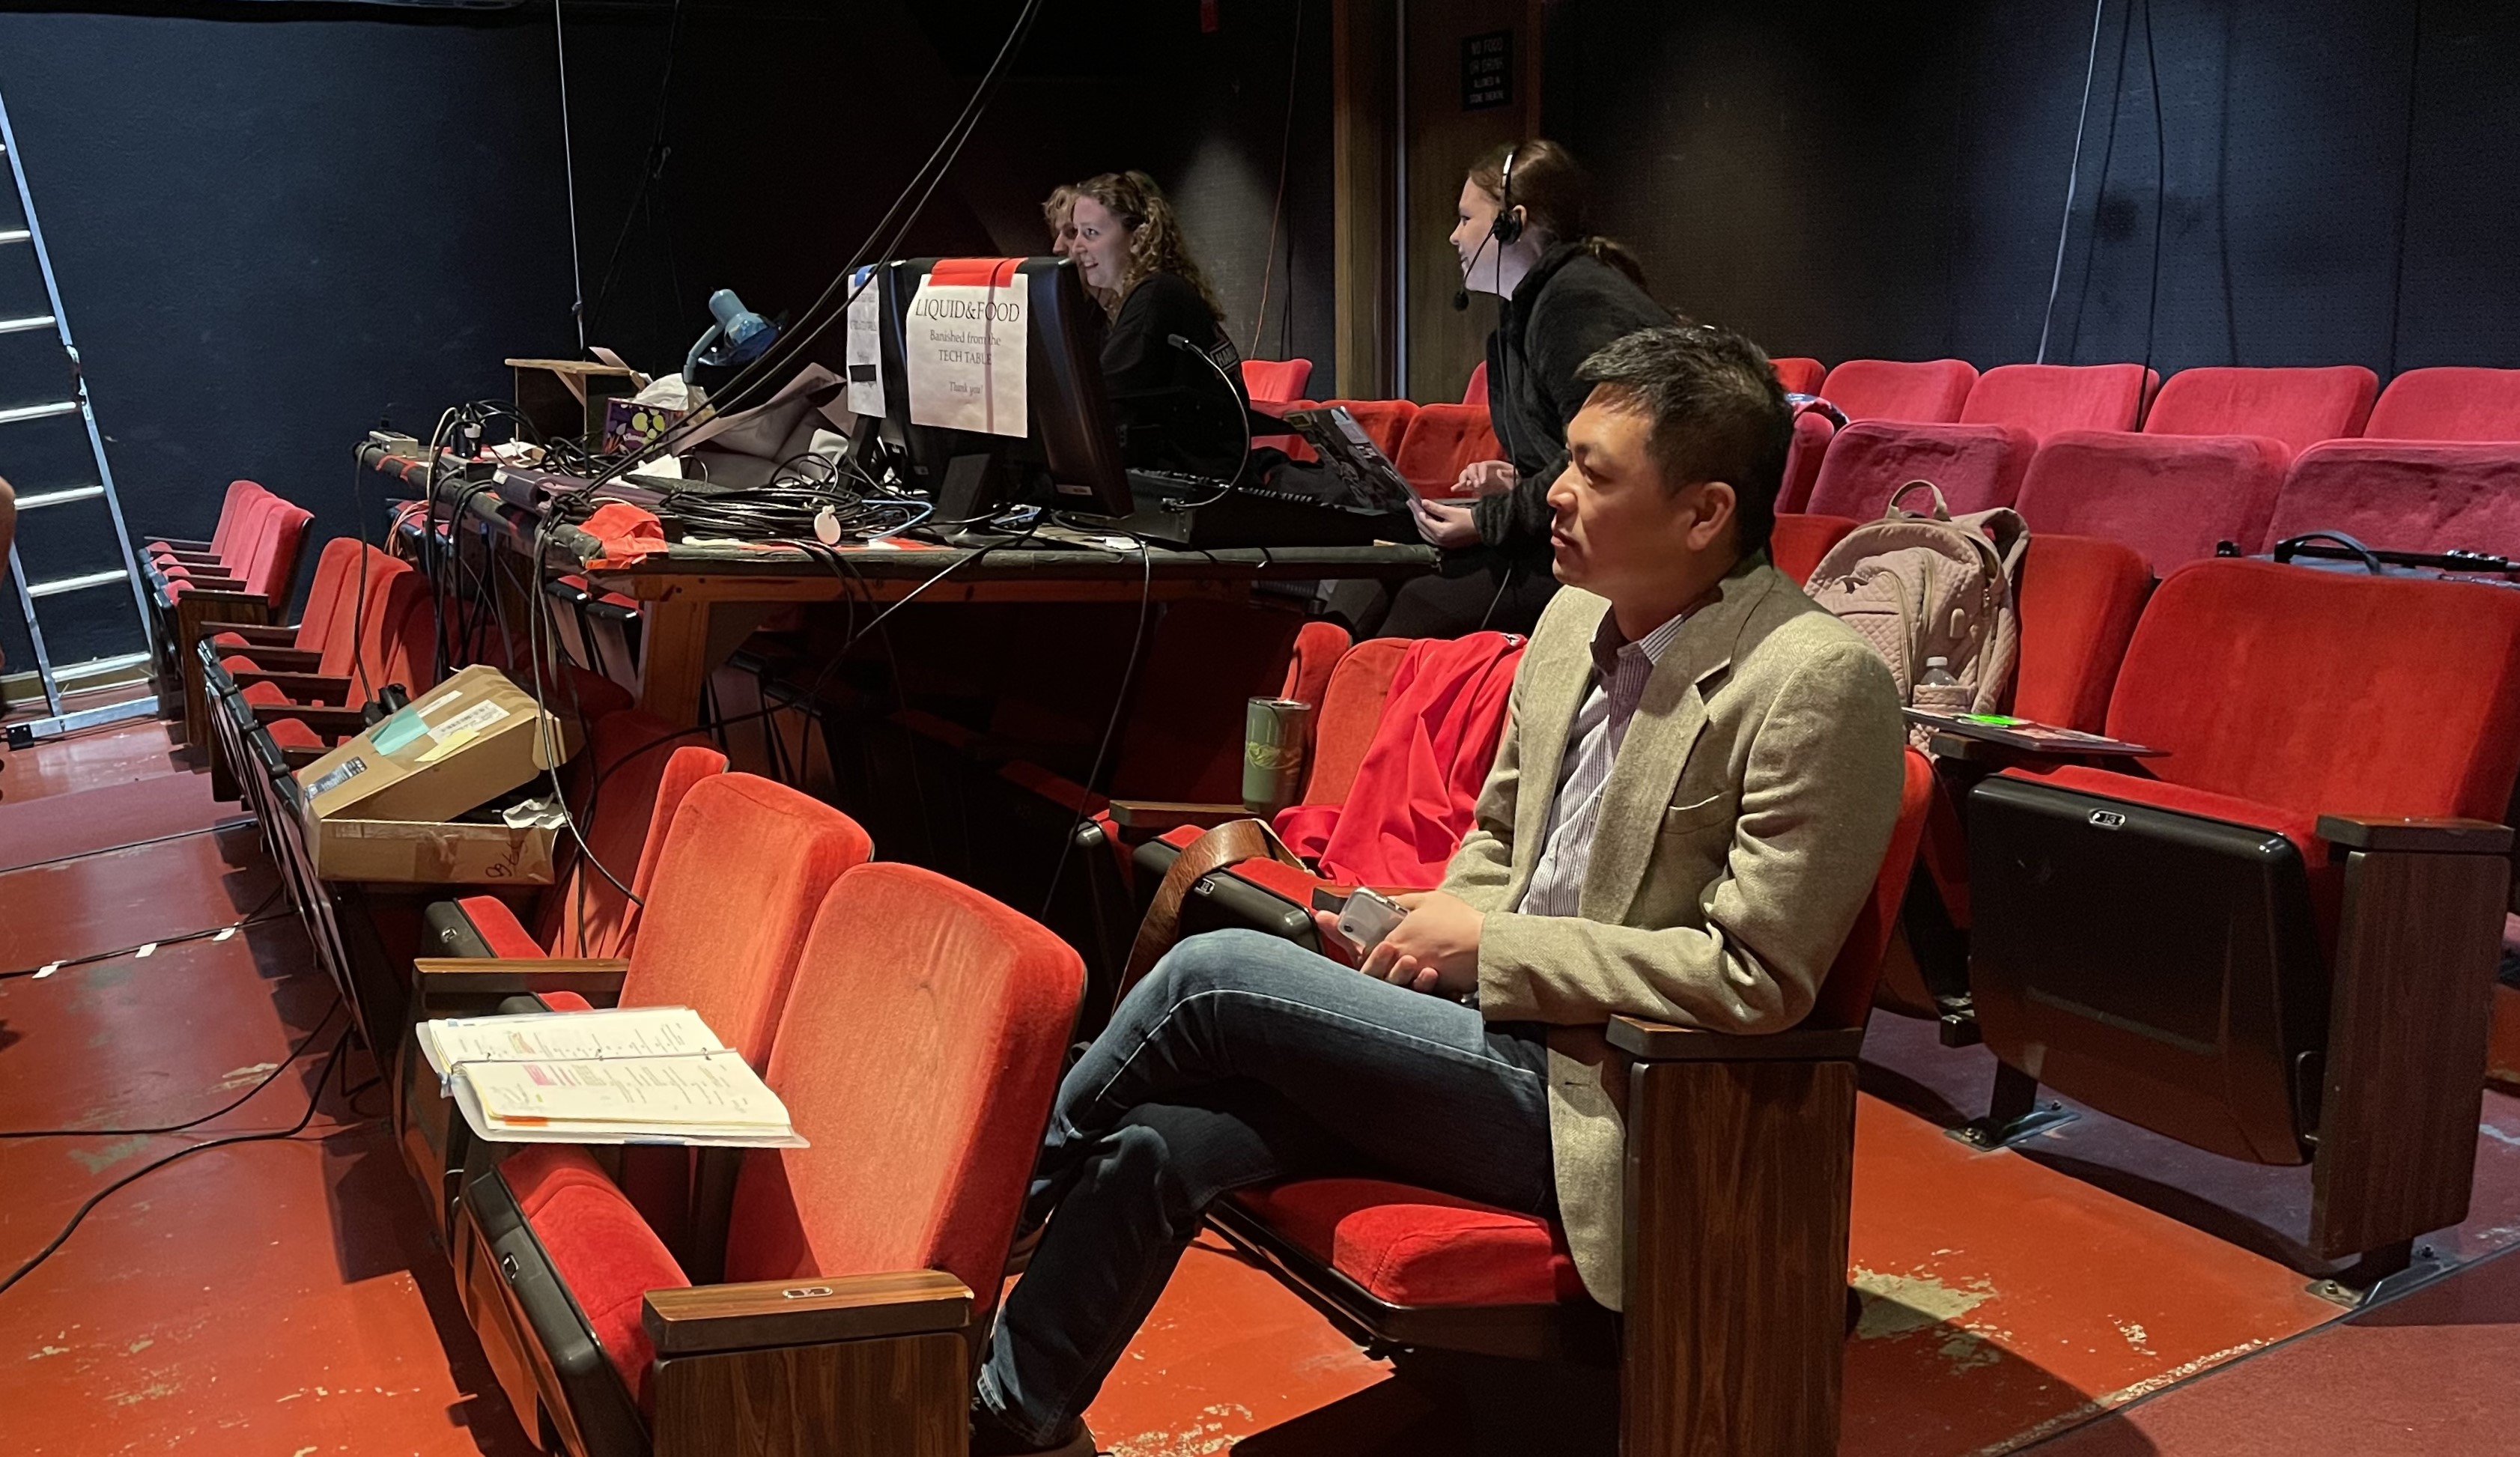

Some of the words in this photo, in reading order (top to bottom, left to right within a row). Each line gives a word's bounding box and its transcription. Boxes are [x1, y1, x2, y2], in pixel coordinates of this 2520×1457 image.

[915, 299, 1020, 322] LIQUID&FOOD
[930, 329, 965, 344] Banished
[968, 332, 987, 345] from
[988, 332, 1001, 346] the
[938, 350, 962, 362] TECH
[965, 351, 992, 365] TABLE
[950, 381, 968, 393] Thank
[2102, 814, 2116, 824] 13
